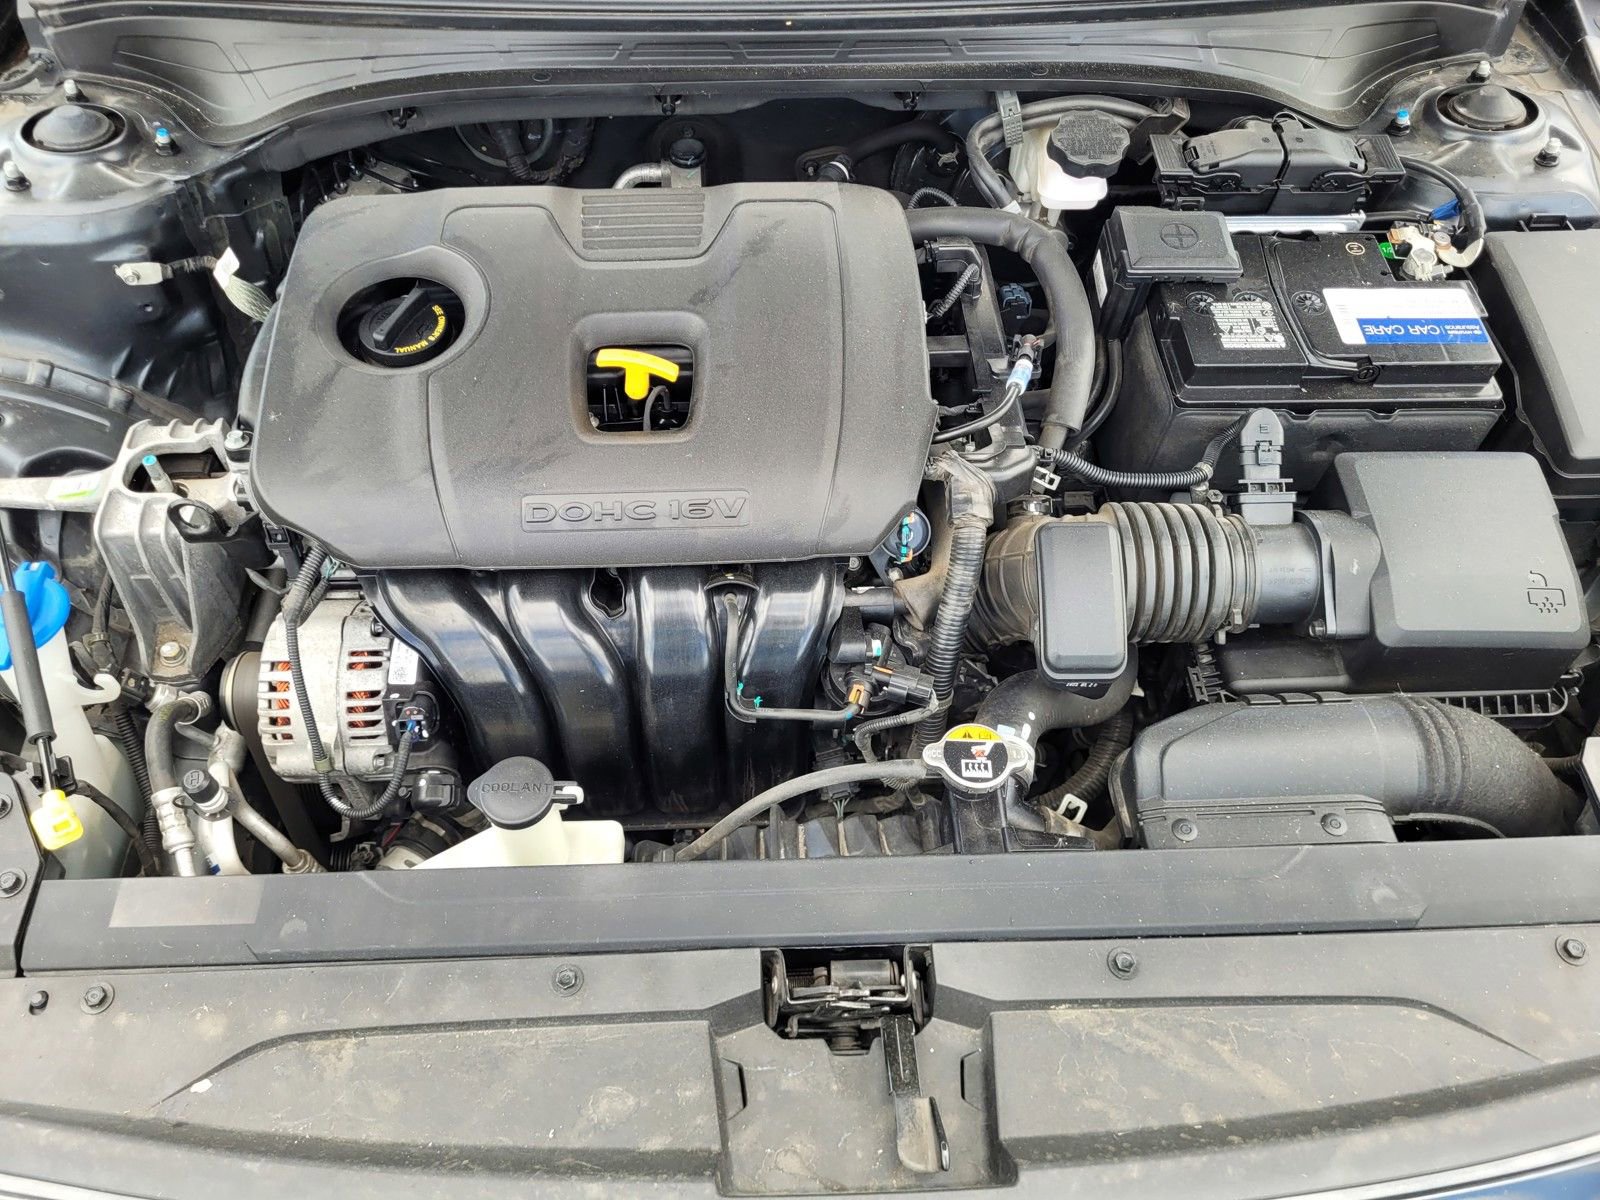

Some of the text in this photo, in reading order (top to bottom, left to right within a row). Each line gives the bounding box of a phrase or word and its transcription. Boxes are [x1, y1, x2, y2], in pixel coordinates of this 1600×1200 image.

[431, 304, 444, 316] SEE
[1362, 324, 1441, 335] CAR CARE
[394, 339, 429, 354] MANUAL
[525, 497, 748, 523] DOHC 16V
[481, 782, 554, 794] COOLANT
